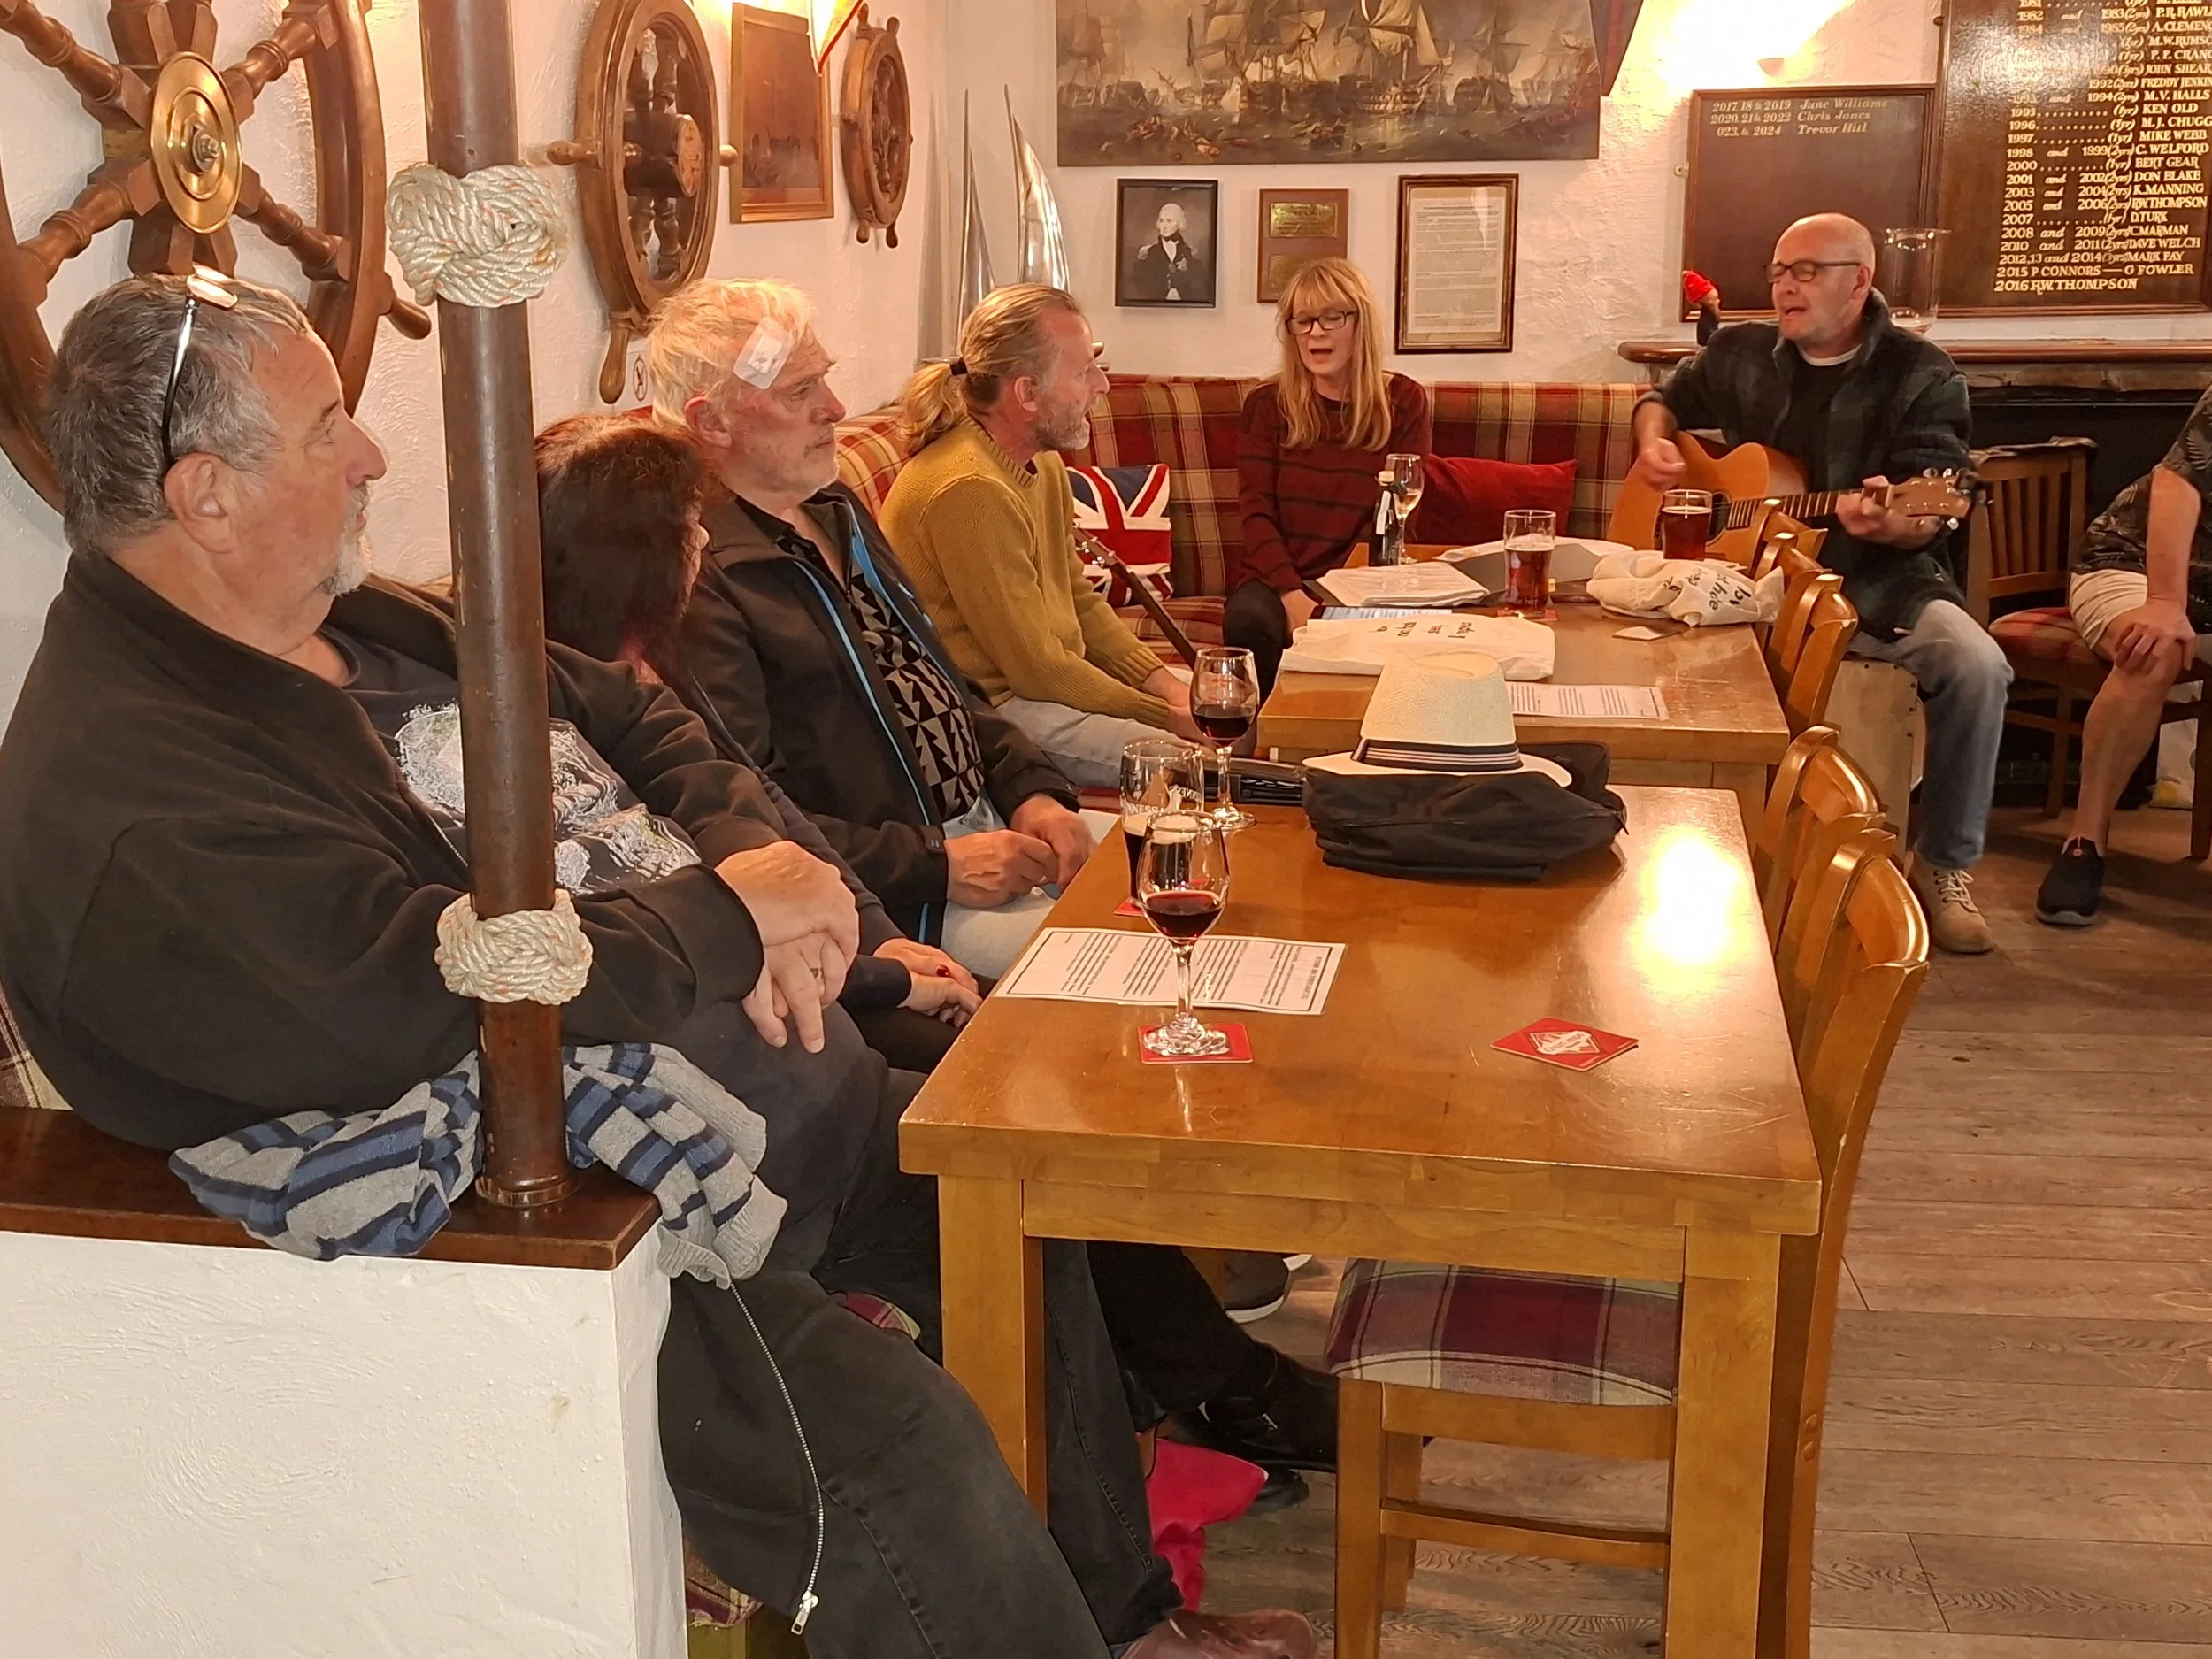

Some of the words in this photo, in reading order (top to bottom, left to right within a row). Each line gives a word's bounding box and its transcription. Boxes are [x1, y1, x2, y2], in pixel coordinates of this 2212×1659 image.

[2017, 10, 2044, 21] 1982
[2101, 8, 2124, 19] 1983
[2145, 63, 2172, 76] JOHN
[2089, 78, 2114, 88] 1992
[2141, 77, 2180, 88] FREDDY
[2087, 92, 2113, 103] 1994
[2173, 89, 2211, 100] HALLS
[1740, 101, 1753, 111] 18
[1763, 99, 1793, 111] 2019
[1800, 99, 1830, 110] June
[1834, 97, 1889, 108] Williams
[2010, 107, 2037, 119] 1995
[2142, 104, 2168, 114] KEN
[2171, 103, 2199, 113] OLD
[1741, 113, 1753, 124] 21
[1763, 112, 1793, 123] 2022
[1797, 111, 1831, 122] Chris
[1835, 110, 1871, 121] Jones
[1753, 126, 1782, 136] 2024
[1797, 123, 1839, 134] Trevor
[1841, 122, 1868, 133] Hill
[2009, 119, 2036, 130] 1996
[2008, 133, 2035, 143] 1997
[2139, 131, 2171, 142] MIKE
[2174, 129, 2208, 140] WEBB
[2007, 147, 2034, 157] 1998
[2047, 147, 2069, 157] and
[2081, 144, 2108, 156] 1999
[2149, 142, 2210, 156] WELFORD
[2007, 161, 2038, 172] 2000
[2135, 157, 2164, 169] BERT
[2166, 157, 2200, 169] GEAR
[2006, 174, 2033, 185] 2001
[2045, 173, 2067, 184] and
[2133, 172, 2161, 182] DON
[2163, 170, 2202, 181] BLAKE
[2004, 187, 2035, 197] 2003
[2044, 187, 2064, 197] and
[2003, 200, 2033, 211] 2005
[2042, 200, 2062, 211] and
[2002, 213, 2034, 225] 2007
[2001, 227, 2034, 238] 2008
[2040, 227, 2066, 238] and
[2075, 226, 2106, 237] 2009
[2000, 241, 2029, 251] 2010
[2039, 240, 2064, 250] and
[2074, 239, 2100, 250] 2011
[2128, 238, 2156, 249] DAVE
[2158, 237, 2201, 249] WELCH
[2044, 252, 2070, 263] and
[2070, 251, 2101, 263] 2014
[2126, 251, 2161, 263] MARK
[2162, 251, 2185, 261] FAY
[1996, 267, 2029, 278] 2015
[2031, 266, 2039, 277] P
[2041, 265, 2101, 276] CONNORS
[2124, 265, 2135, 275] G
[2137, 264, 2194, 275] FOWLER
[1993, 280, 2029, 292] 2016
